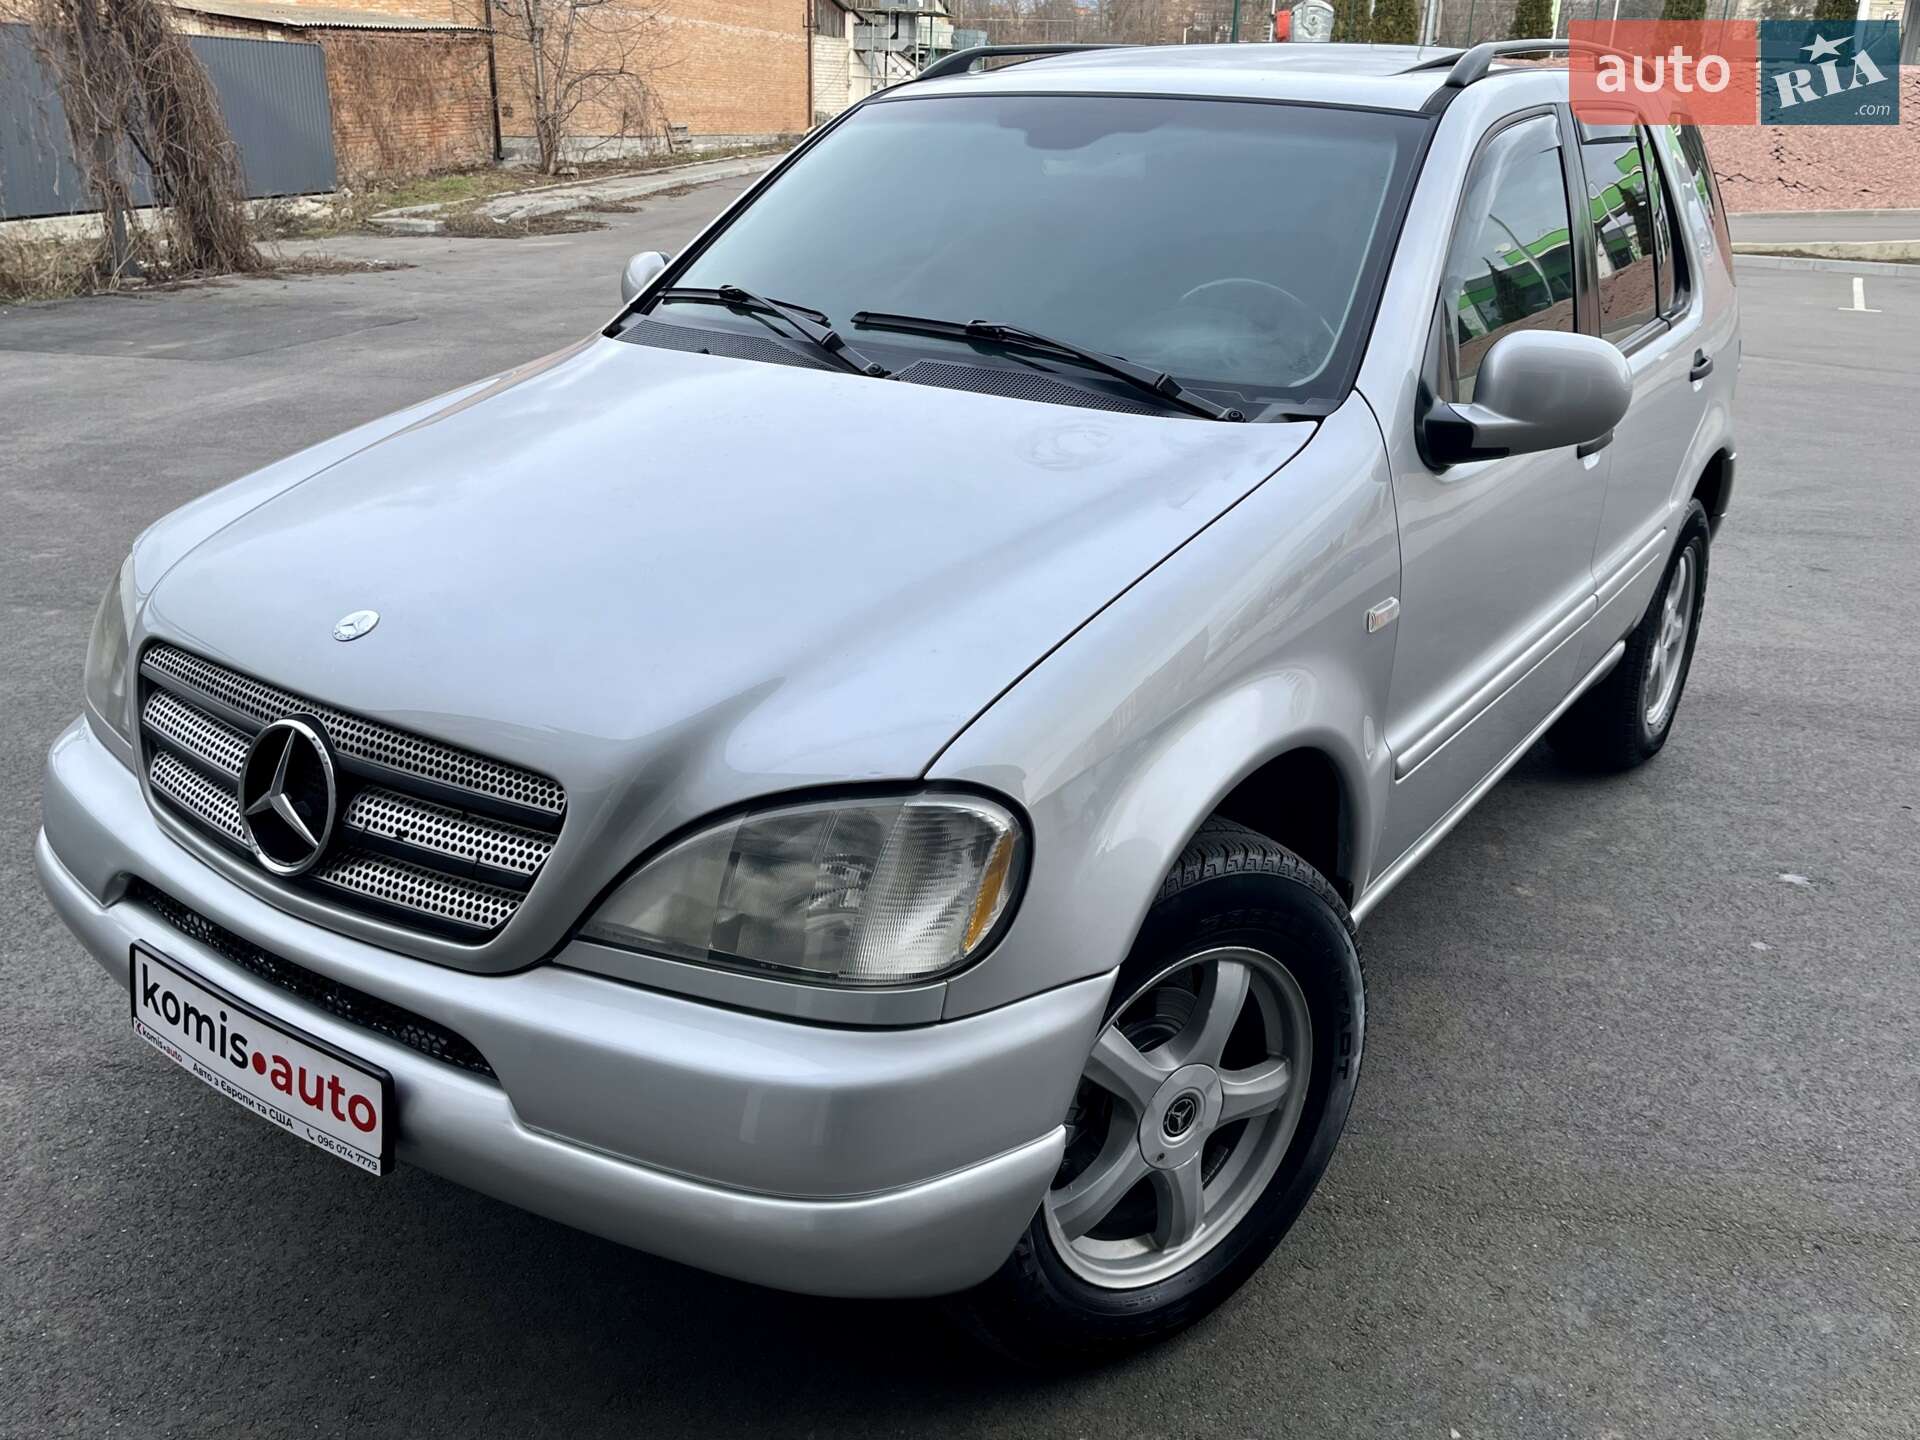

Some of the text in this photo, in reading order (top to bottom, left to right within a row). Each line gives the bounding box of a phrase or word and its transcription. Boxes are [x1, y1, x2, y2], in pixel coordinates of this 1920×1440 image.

[193, 1063, 212, 1082] Авто
[221, 1080, 255, 1108] Європи
[256, 1103, 267, 1115] та
[269, 1108, 294, 1129] США
[317, 1134, 378, 1171] 096 074 7779
